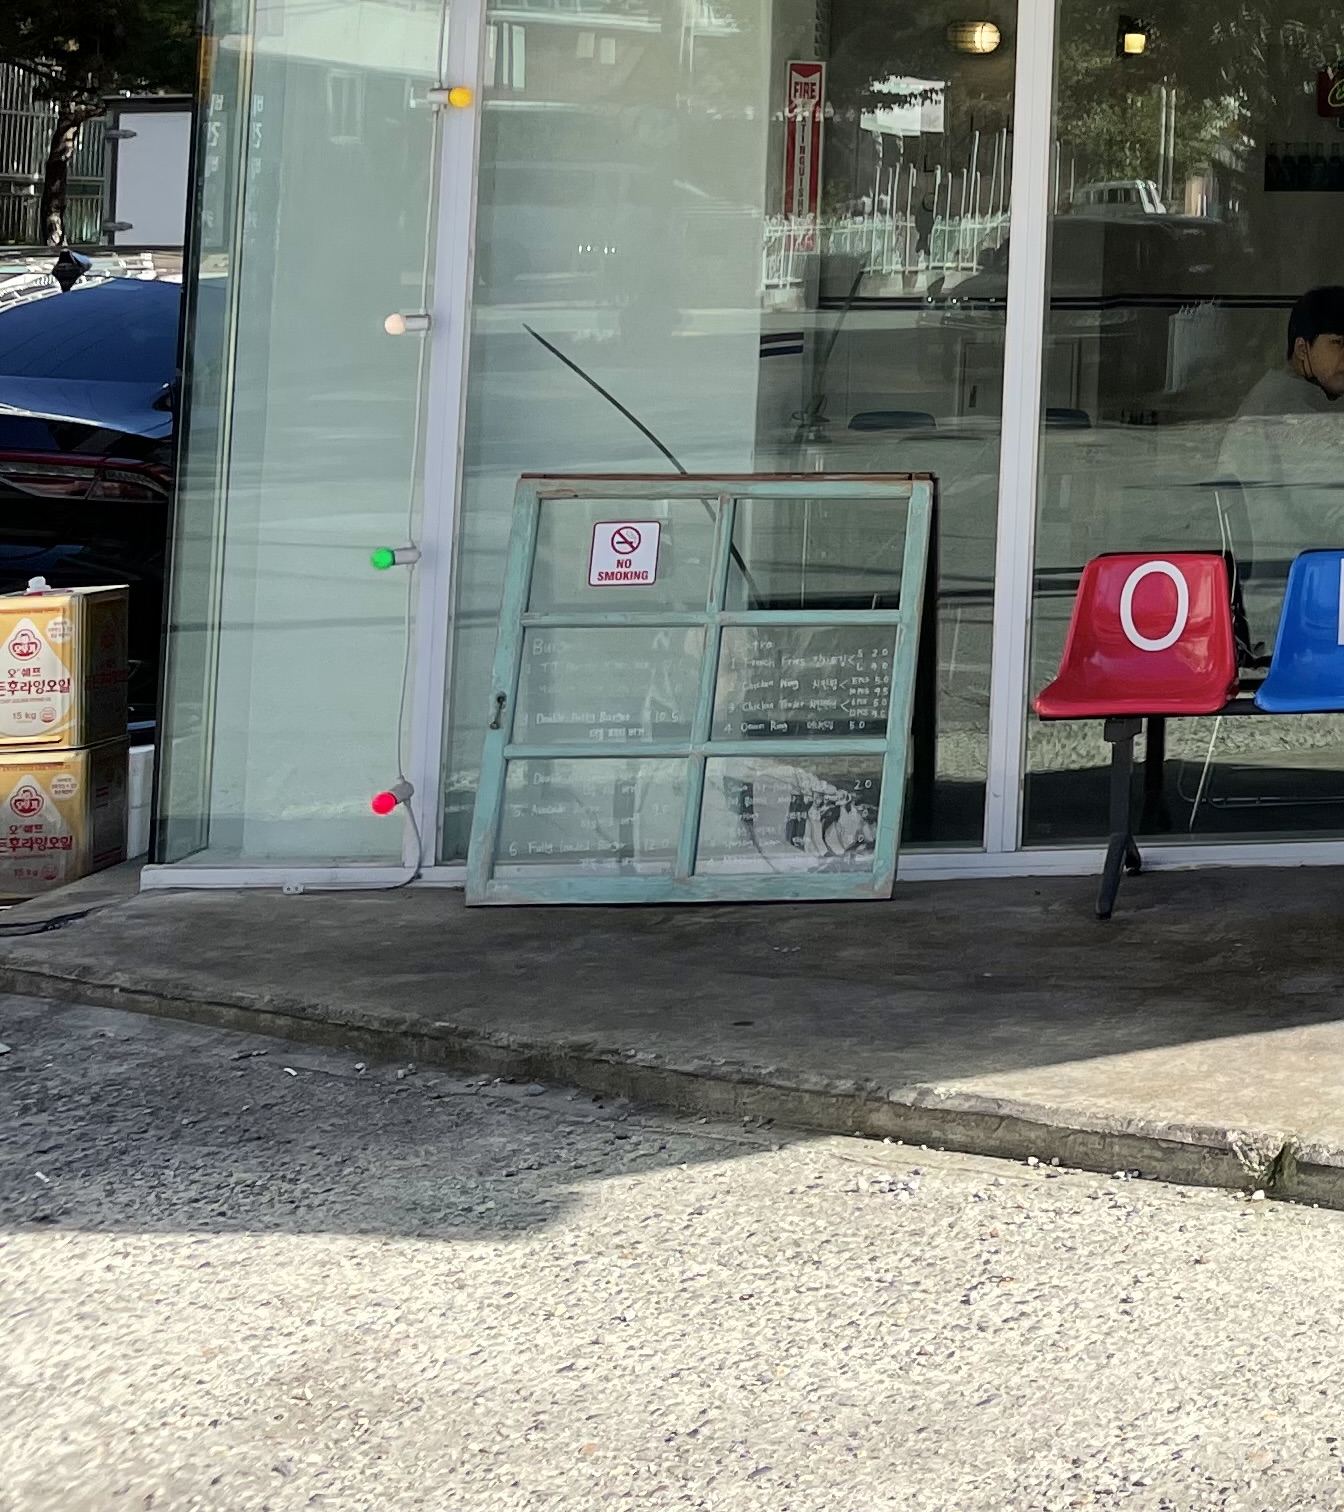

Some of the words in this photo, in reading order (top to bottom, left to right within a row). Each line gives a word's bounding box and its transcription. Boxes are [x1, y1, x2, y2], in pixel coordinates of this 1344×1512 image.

[794, 81, 817, 98] FIRE
[616, 559, 632, 569] NO
[597, 571, 649, 582] SMOKING
